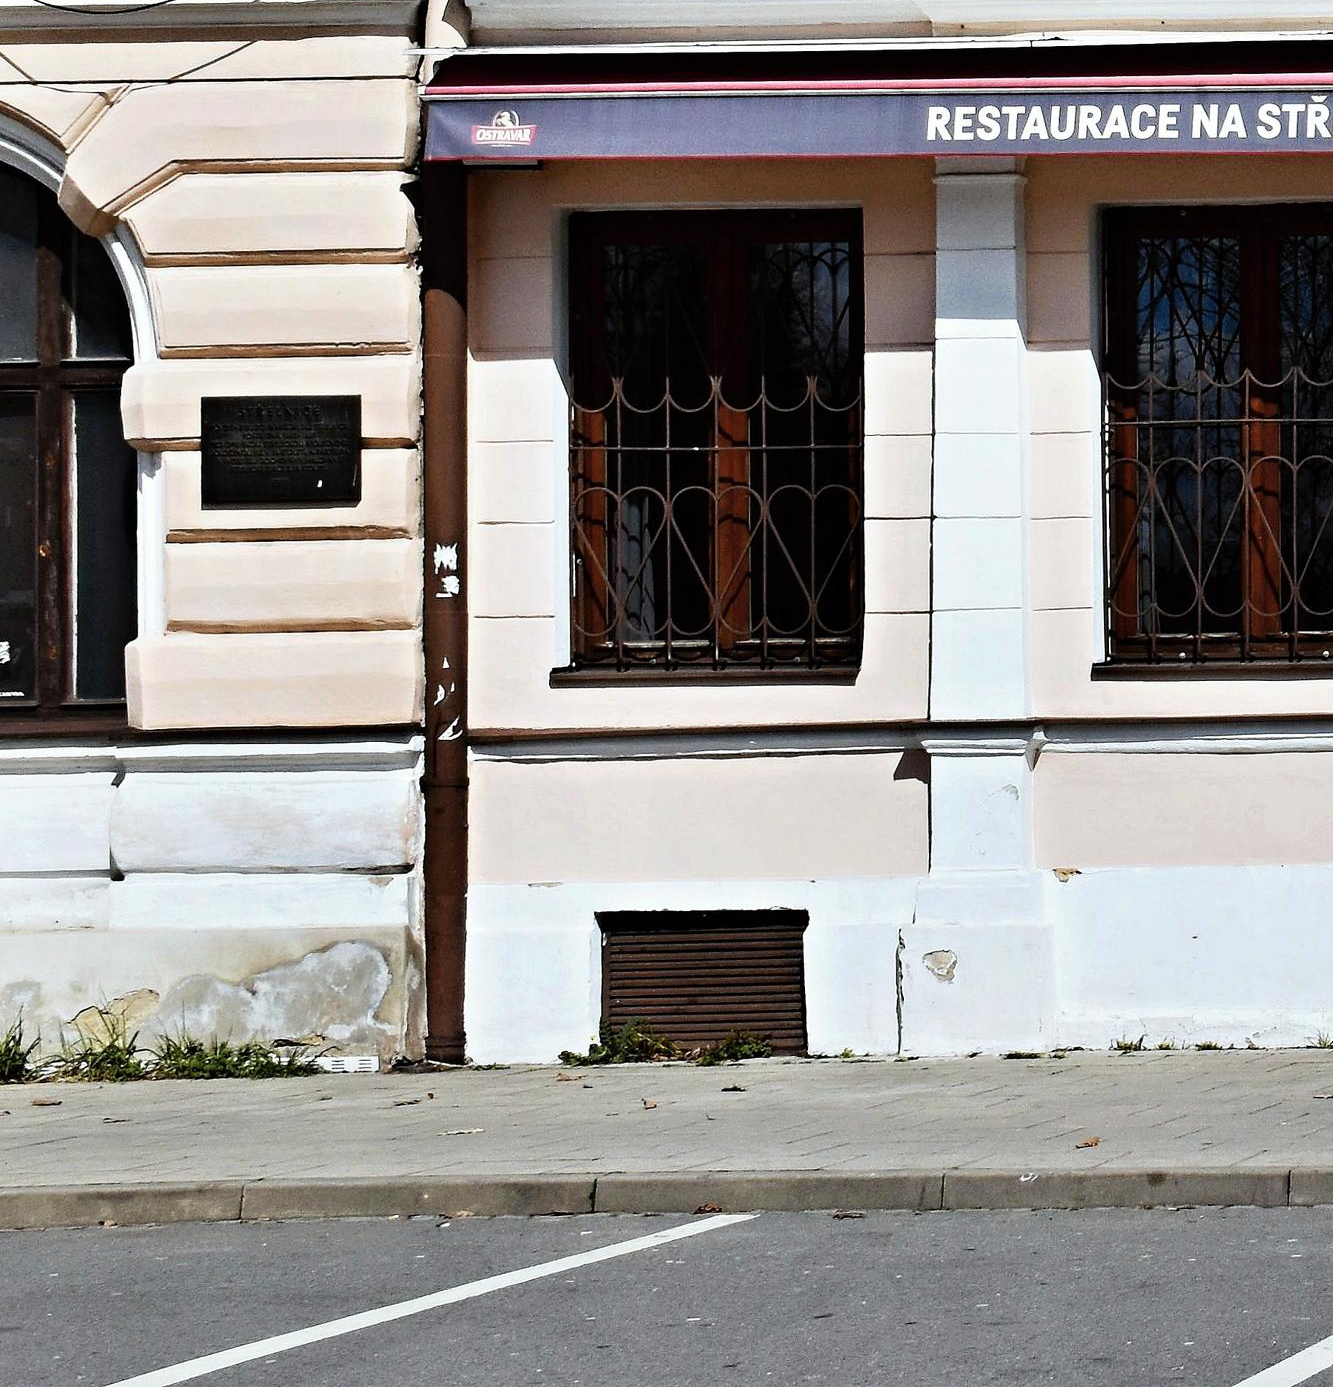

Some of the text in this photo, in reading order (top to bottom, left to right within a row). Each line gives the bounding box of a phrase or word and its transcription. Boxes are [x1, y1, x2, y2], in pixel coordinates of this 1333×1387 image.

[475, 128, 531, 142] OSTRAVAR
[926, 103, 1181, 141] RESTAURACE
[1191, 103, 1249, 140] NA
